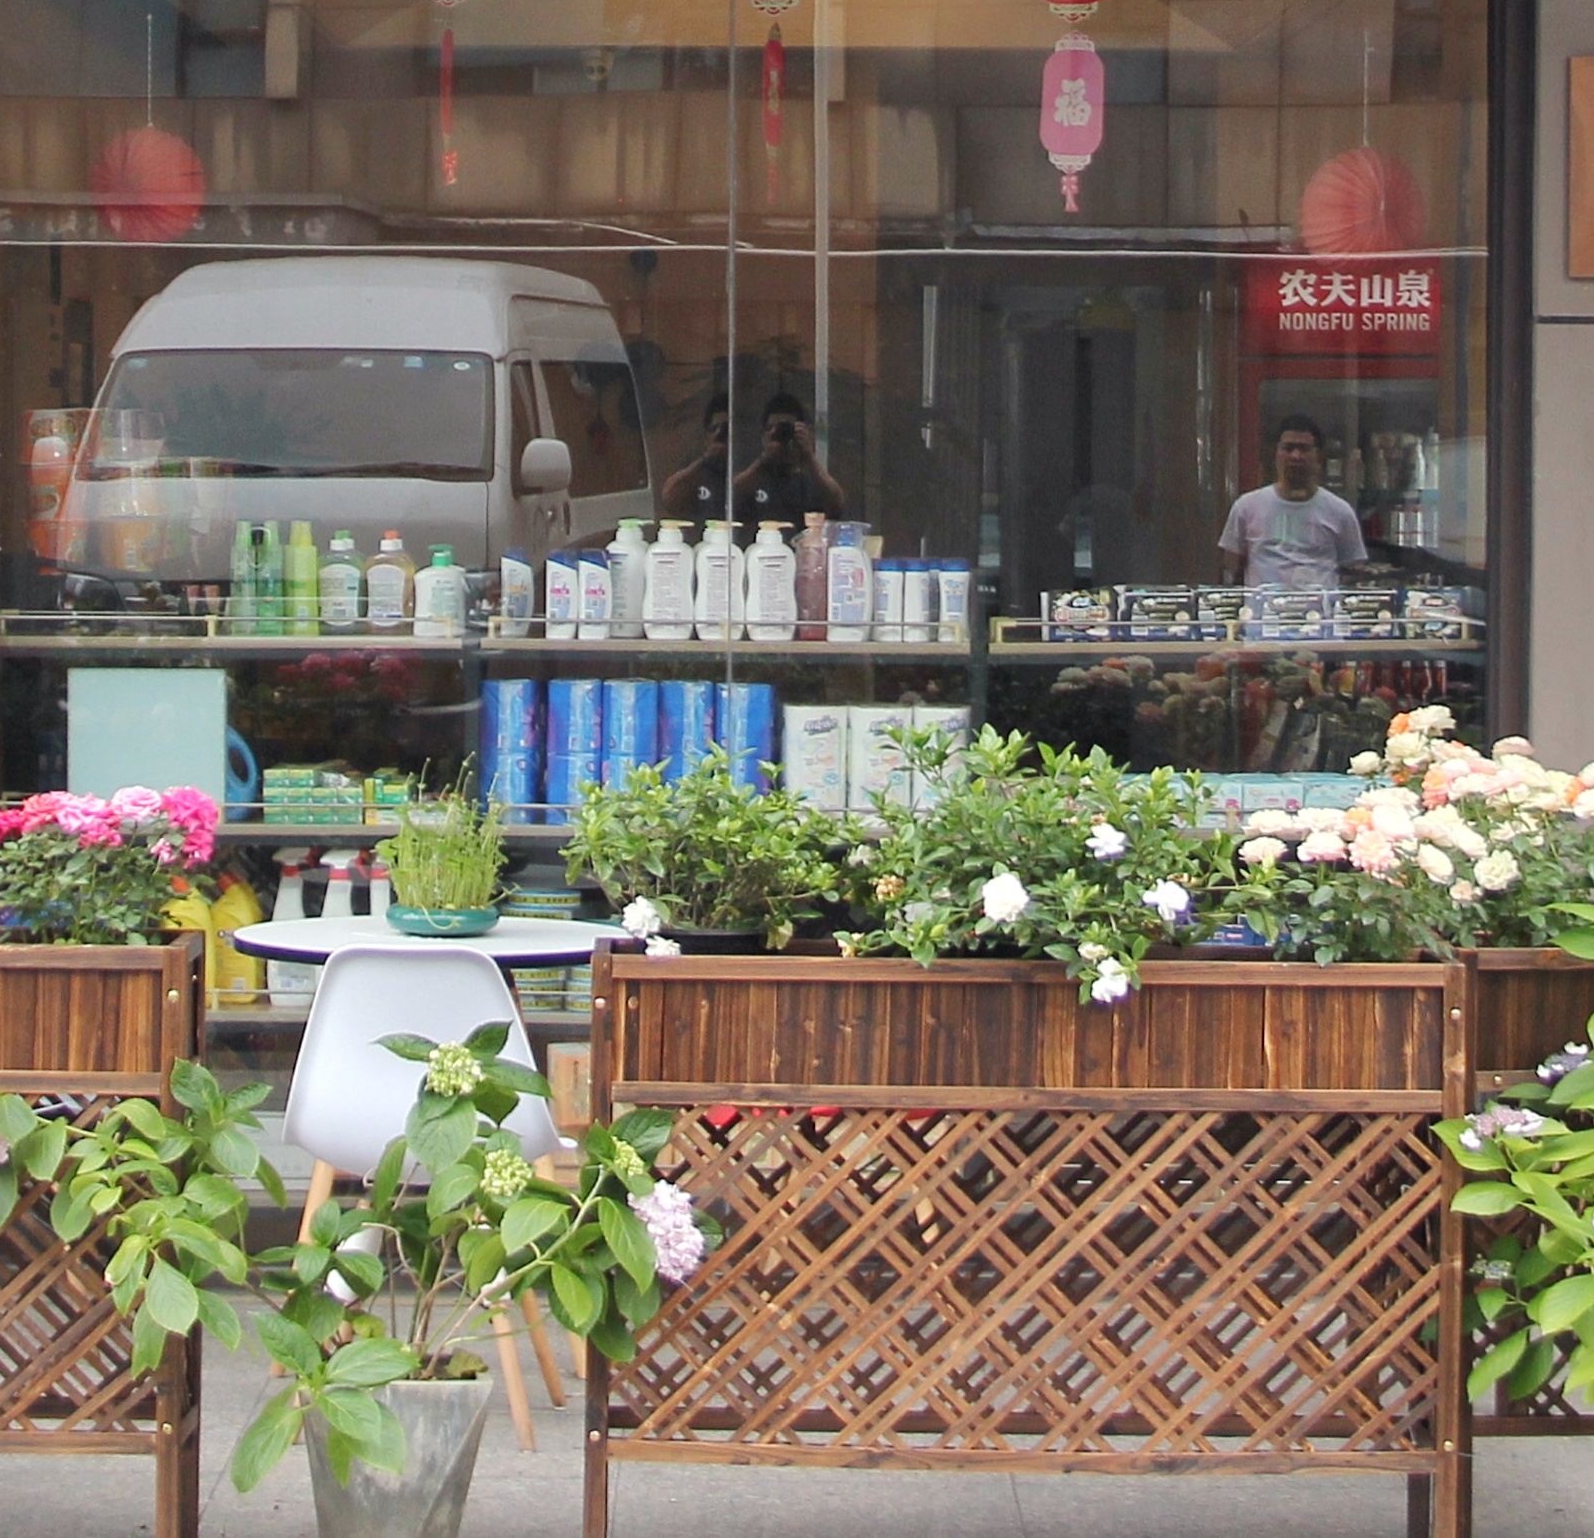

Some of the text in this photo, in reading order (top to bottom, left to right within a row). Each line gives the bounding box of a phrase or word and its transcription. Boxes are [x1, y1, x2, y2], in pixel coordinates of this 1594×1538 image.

[1053, 78, 1092, 127] 福
[1278, 269, 1432, 308] 农夫山泉
[1278, 312, 1431, 331] NONGFU SPRING
